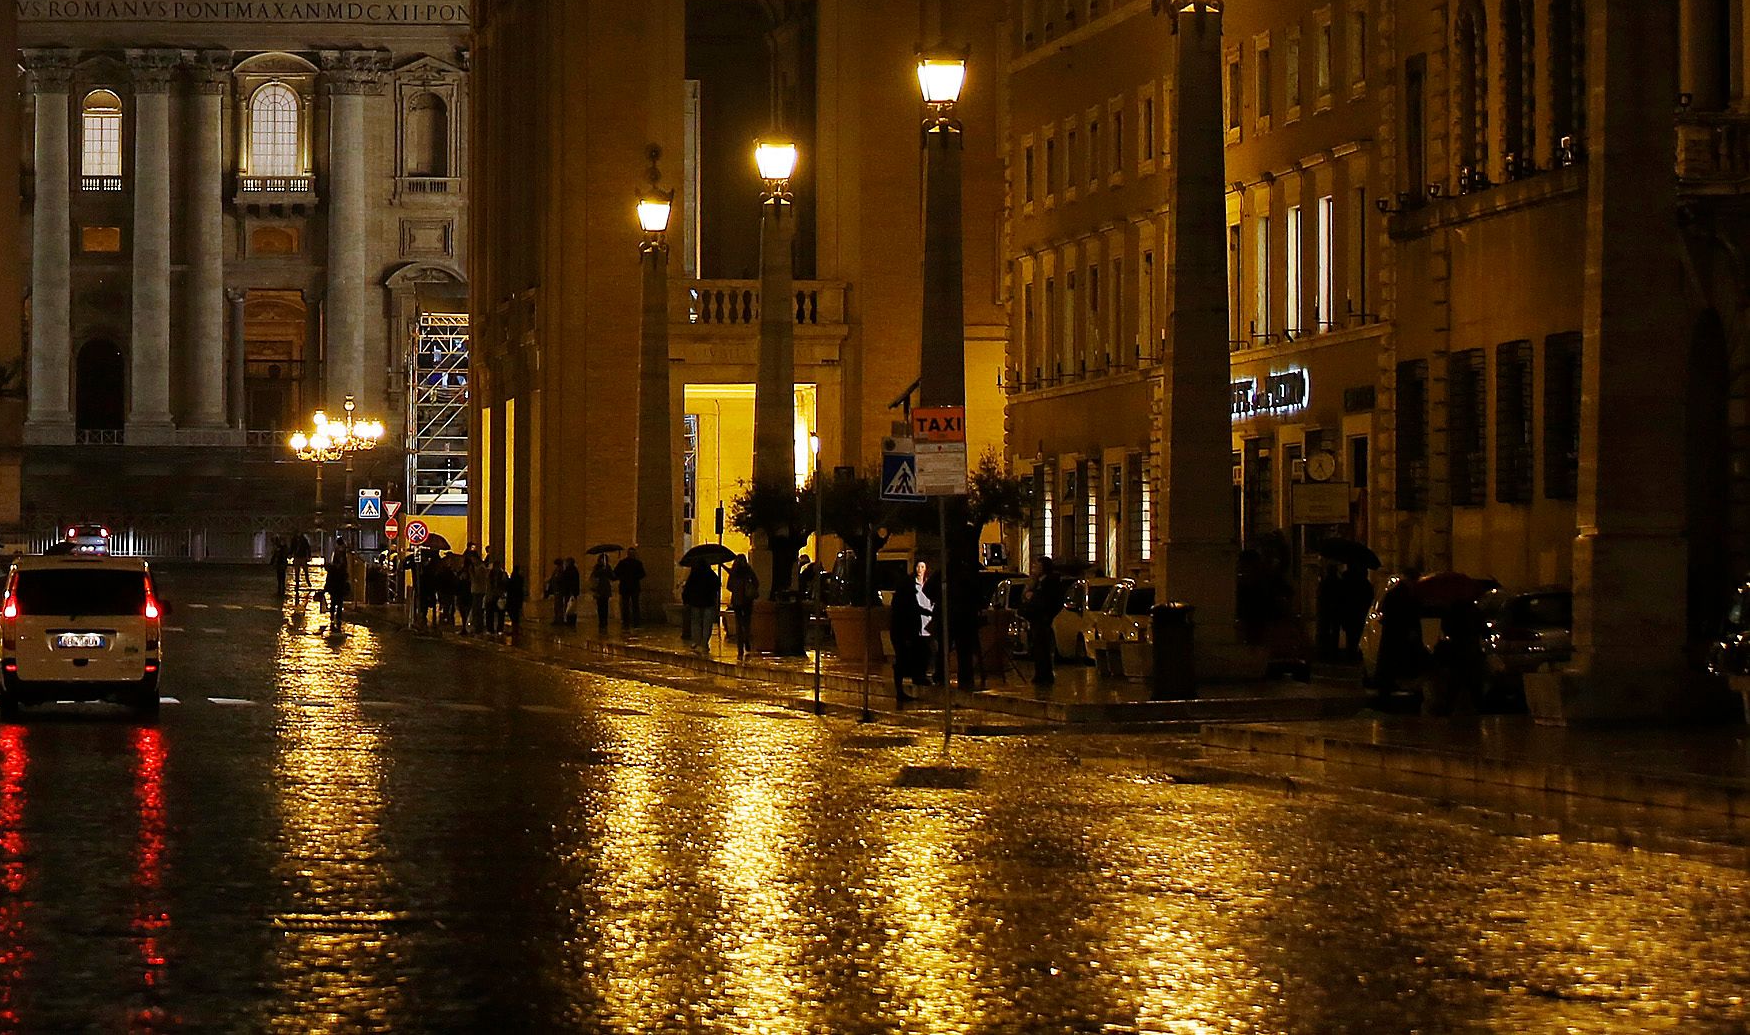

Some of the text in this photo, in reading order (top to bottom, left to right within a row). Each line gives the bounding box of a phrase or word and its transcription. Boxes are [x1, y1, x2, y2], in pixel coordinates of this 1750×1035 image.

[49, 1, 167, 18] ROMANVS
[174, 2, 231, 18] PONT
[235, 2, 291, 19] MAX
[326, 3, 418, 20] MDCXII
[916, 417, 961, 432] TAXI
